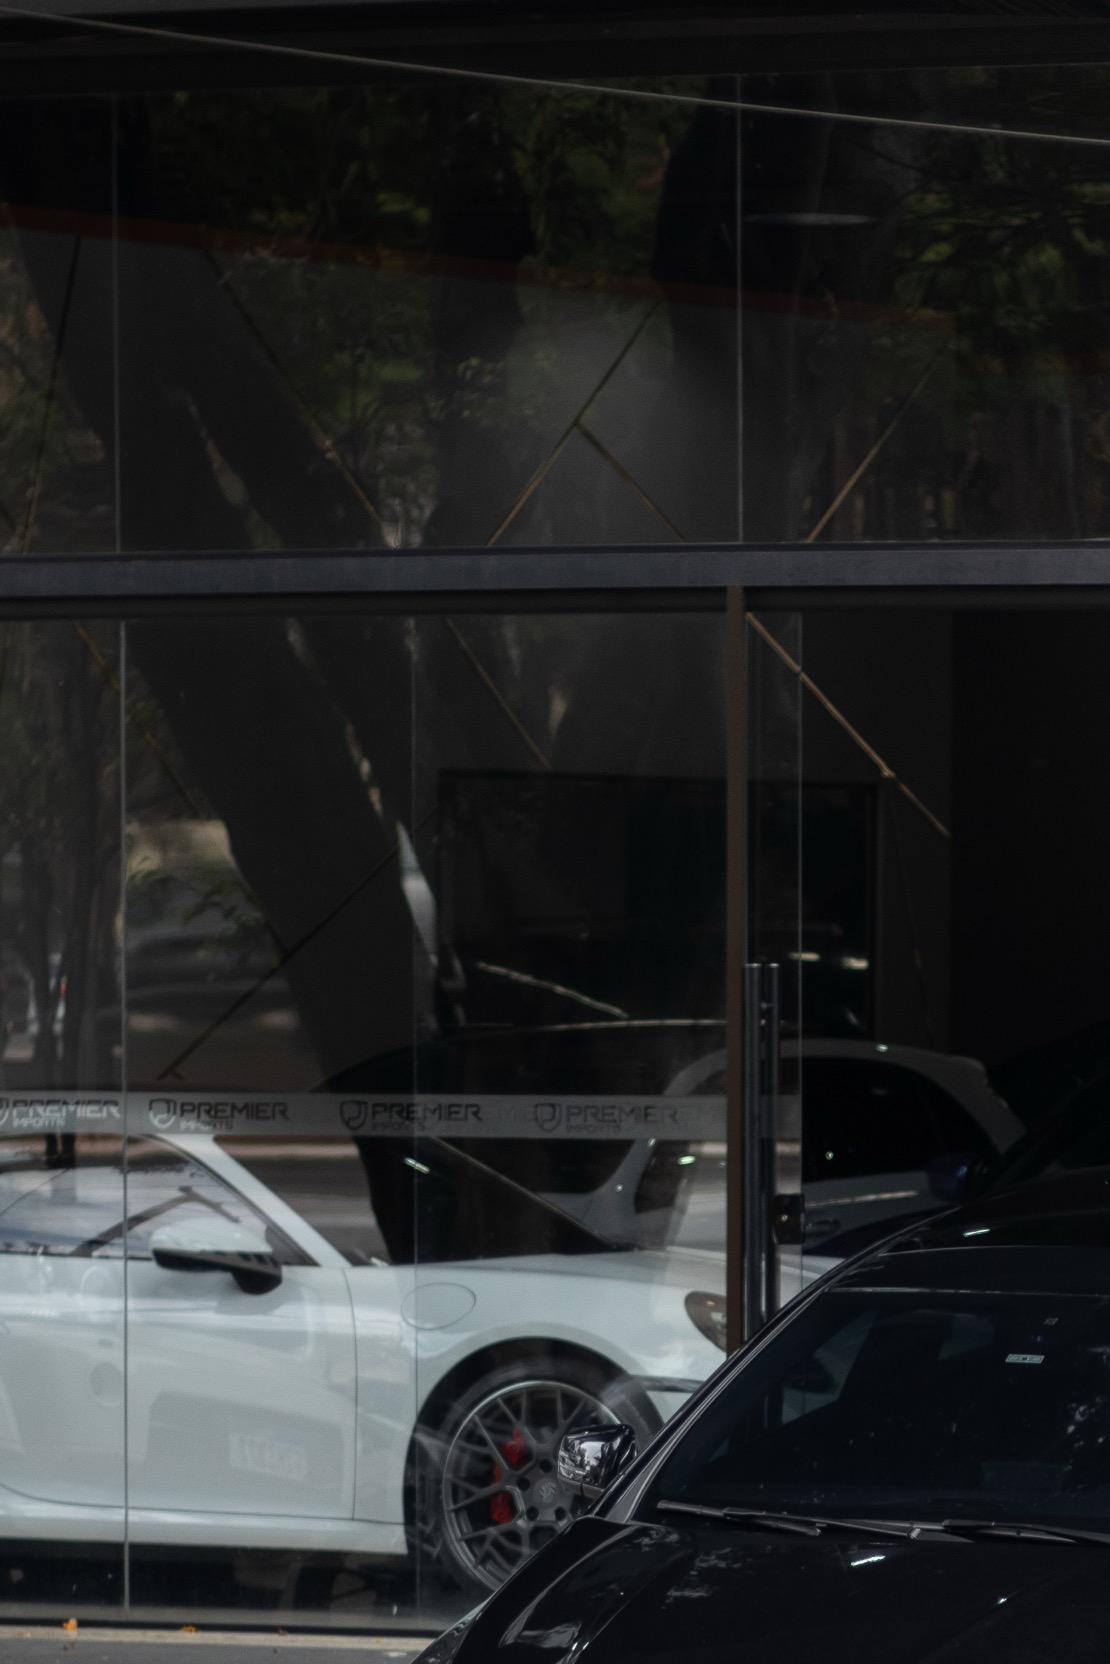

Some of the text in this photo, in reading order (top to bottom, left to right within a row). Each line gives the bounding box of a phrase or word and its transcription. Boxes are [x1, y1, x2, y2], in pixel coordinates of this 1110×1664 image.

[12, 1100, 121, 1118] PREMIER
[181, 1102, 290, 1120] PREMIER
[371, 1103, 484, 1122] PREMIER
[566, 1104, 679, 1124] PREMIER
[13, 1118, 65, 1129] IMPORTS
[180, 1120, 234, 1130] IMPORTS
